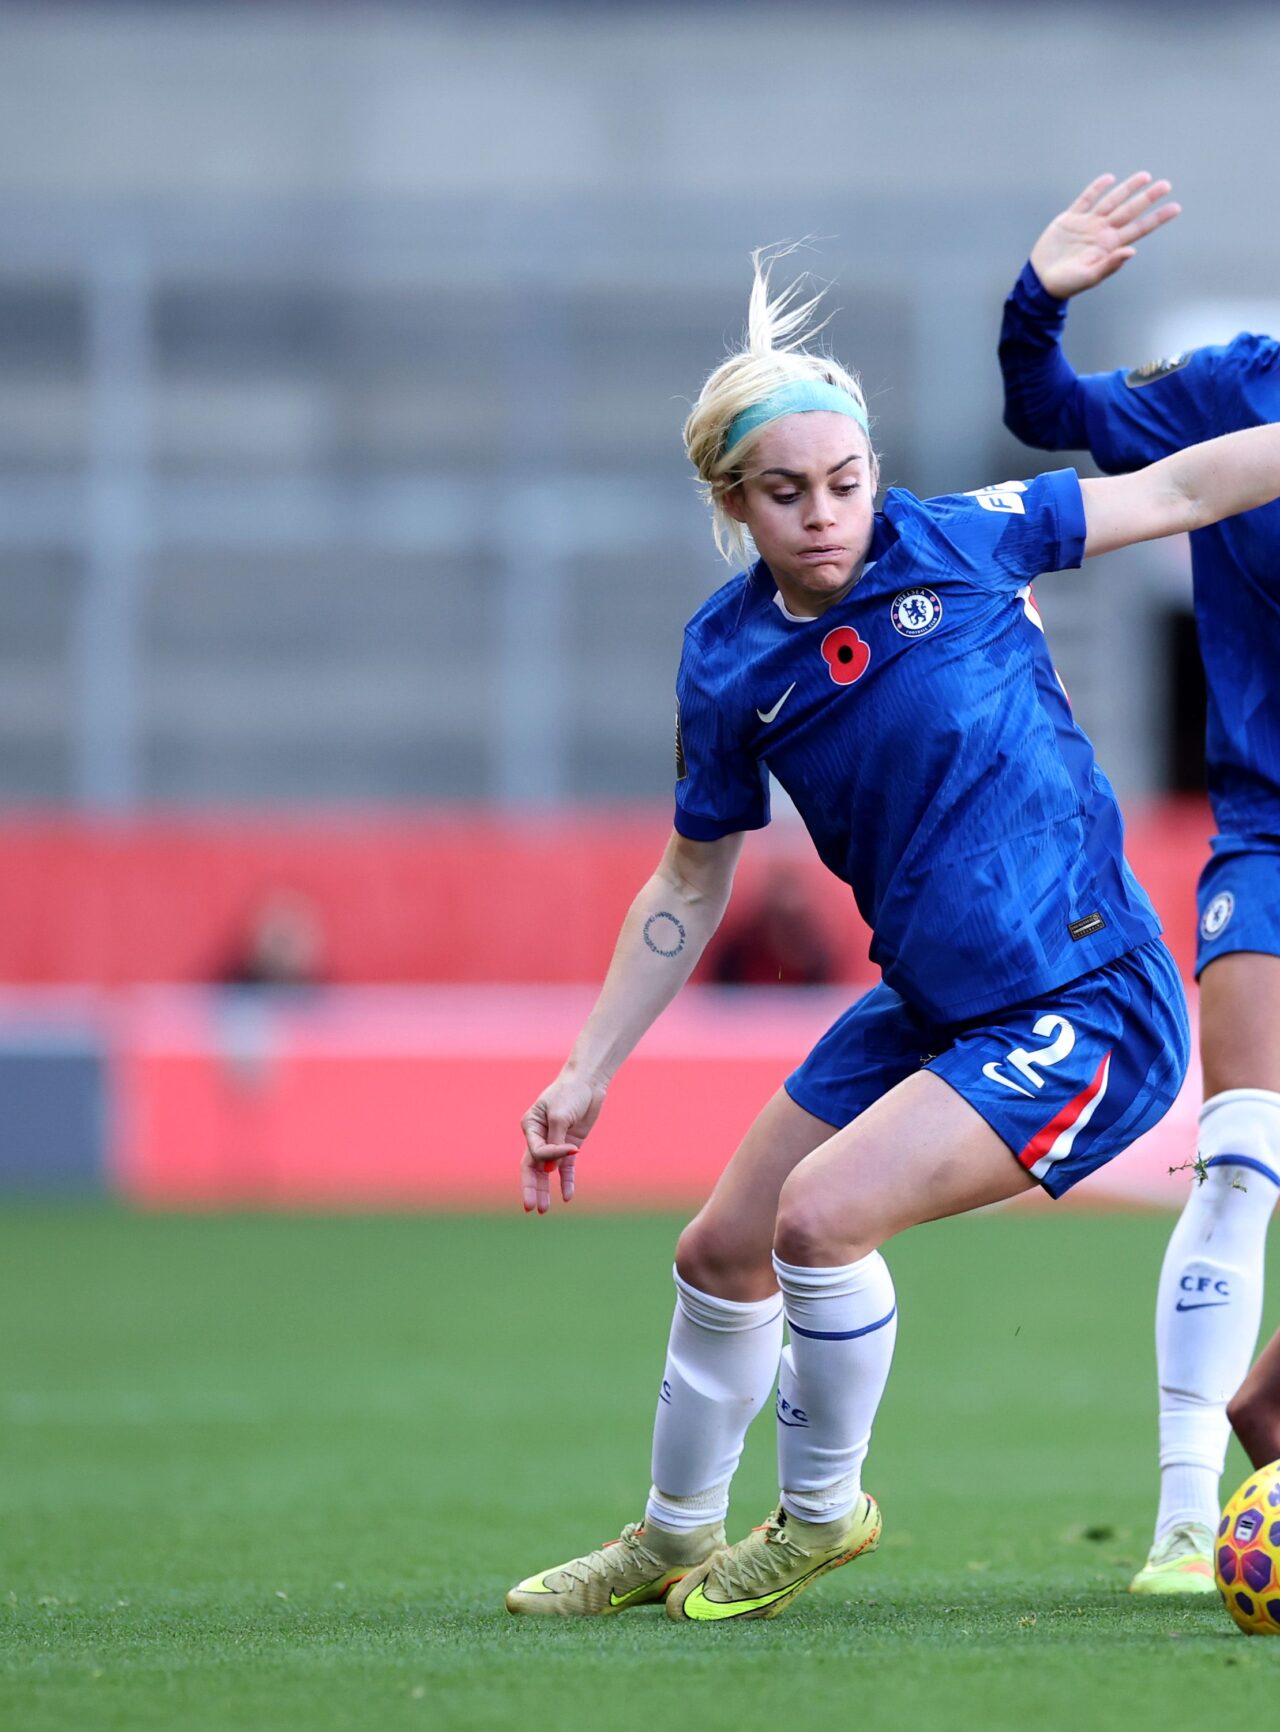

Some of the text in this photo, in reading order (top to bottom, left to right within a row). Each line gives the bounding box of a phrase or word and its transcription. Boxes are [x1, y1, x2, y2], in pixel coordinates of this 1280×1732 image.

[894, 590, 925, 607] CHELSEA
[1006, 1014, 1076, 1089] 2
[1180, 1275, 1230, 1296] CFC
